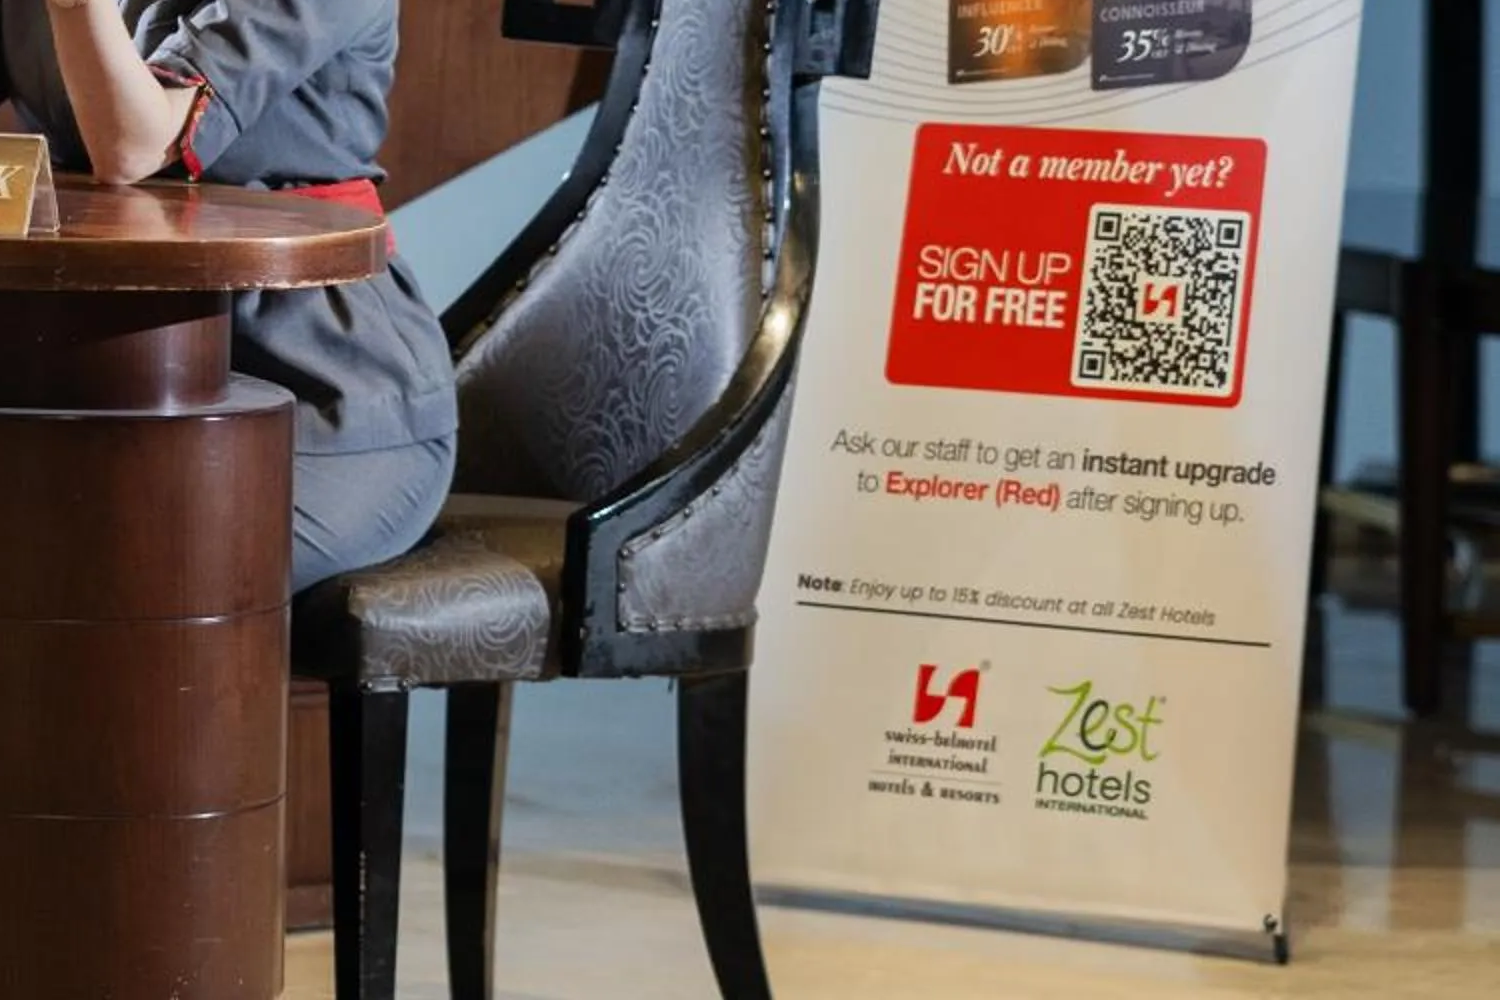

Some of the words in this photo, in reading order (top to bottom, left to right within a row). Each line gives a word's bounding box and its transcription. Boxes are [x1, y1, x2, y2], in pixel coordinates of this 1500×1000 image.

[1099, 0, 1205, 23] CONNOISSEUR
[943, 141, 1003, 177] Not
[1008, 157, 1030, 178] a
[1038, 148, 1164, 186] member
[1164, 155, 1235, 198] yet?
[917, 244, 1012, 282] SIGN
[1016, 250, 1072, 286] UP
[912, 281, 978, 324] FOR
[983, 285, 1069, 330] FREE
[830, 429, 877, 456] Ask
[881, 438, 917, 457] our
[924, 437, 971, 463] staff
[976, 442, 998, 465] to
[1004, 446, 1042, 474] get
[1046, 450, 1075, 471] an
[1081, 447, 1169, 478] instant
[1174, 459, 1277, 488] upgrade
[857, 470, 880, 493] to
[885, 471, 990, 501] Explorer
[994, 478, 1062, 512] (Red)
[1065, 486, 1118, 513] after
[1123, 492, 1203, 525] signing
[1209, 500, 1246, 525] up.
[849, 578, 898, 600] Enjoy
[900, 586, 924, 601] up
[929, 586, 947, 601] to
[953, 587, 981, 605] 15%
[985, 591, 1063, 614] discount
[1067, 600, 1088, 615] at
[1091, 600, 1115, 617] all
[1117, 602, 1157, 621] Zest
[1160, 606, 1217, 627] Hotels
[1041, 679, 1163, 766] Zest
[921, 781, 933, 798] &
[1037, 762, 1152, 805] hotels
[1035, 798, 1148, 821] INTERNATIONAL
